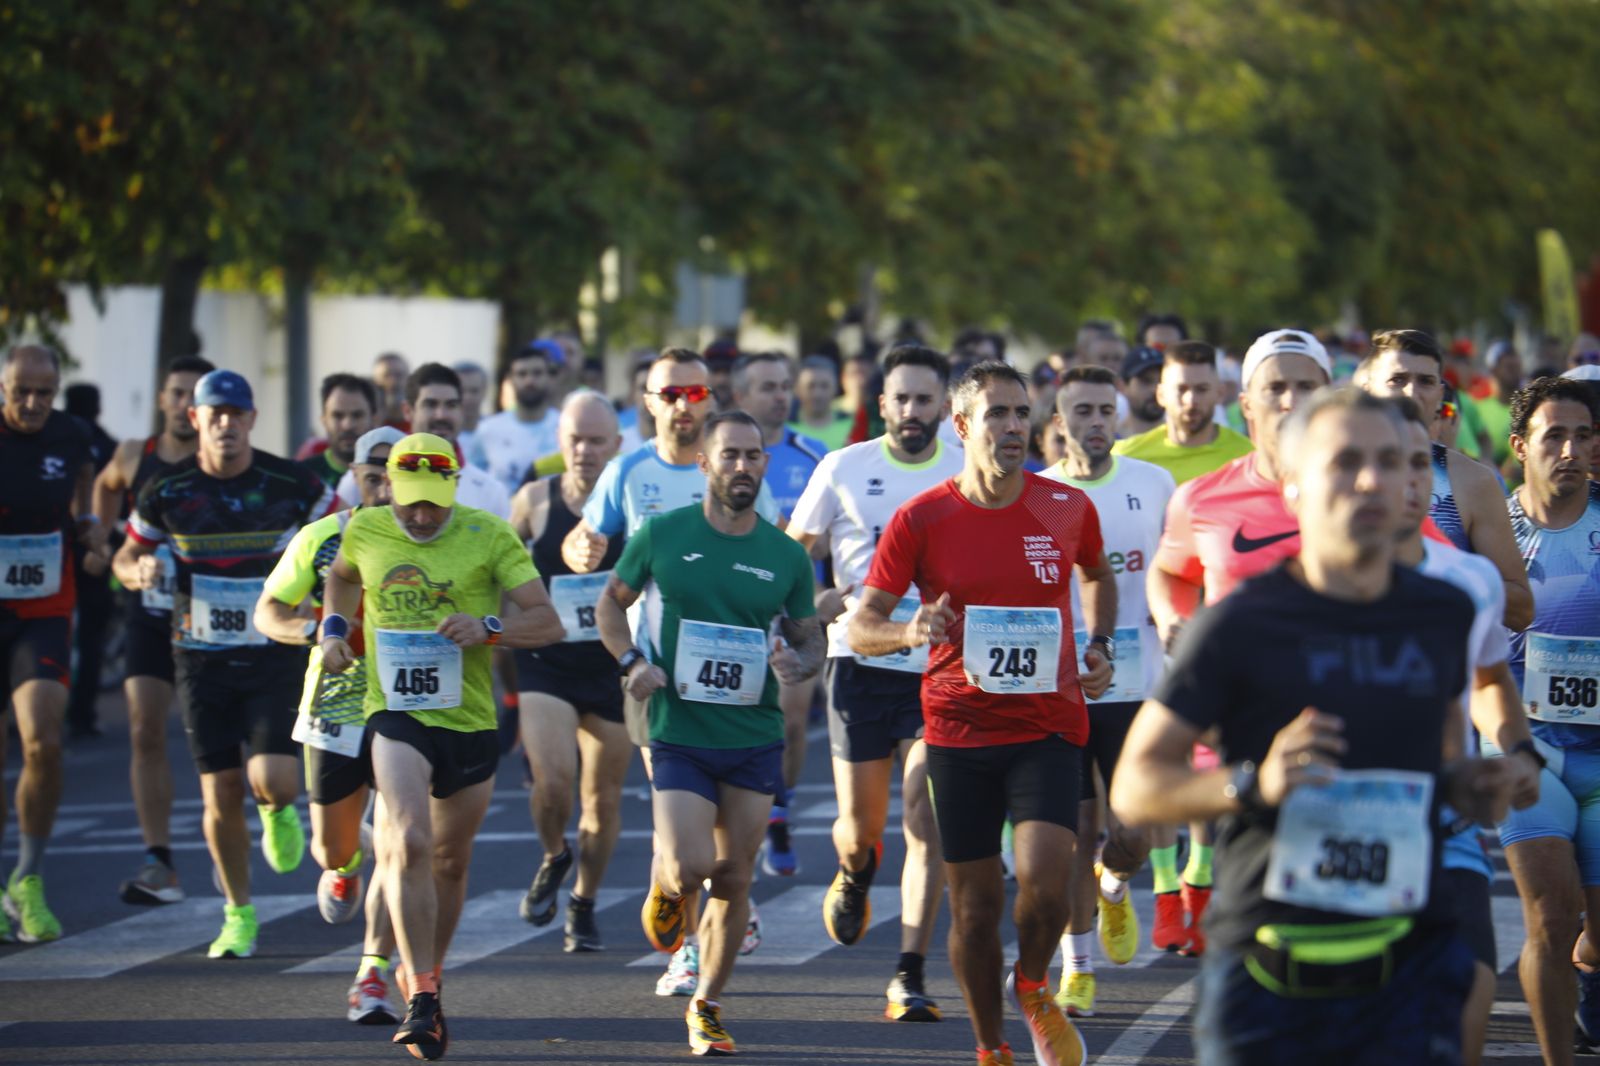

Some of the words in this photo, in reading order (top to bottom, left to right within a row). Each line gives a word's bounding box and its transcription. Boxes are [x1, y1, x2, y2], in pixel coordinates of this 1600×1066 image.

[5, 564, 45, 586] 405
[1108, 548, 1145, 574] ea
[575, 606, 596, 628] 13
[969, 623, 1005, 633] MEDIA
[697, 660, 743, 690] 458
[988, 647, 1037, 677] 243
[1302, 635, 1436, 688] FILA
[393, 667, 440, 695] 465
[1548, 675, 1598, 708] 536
